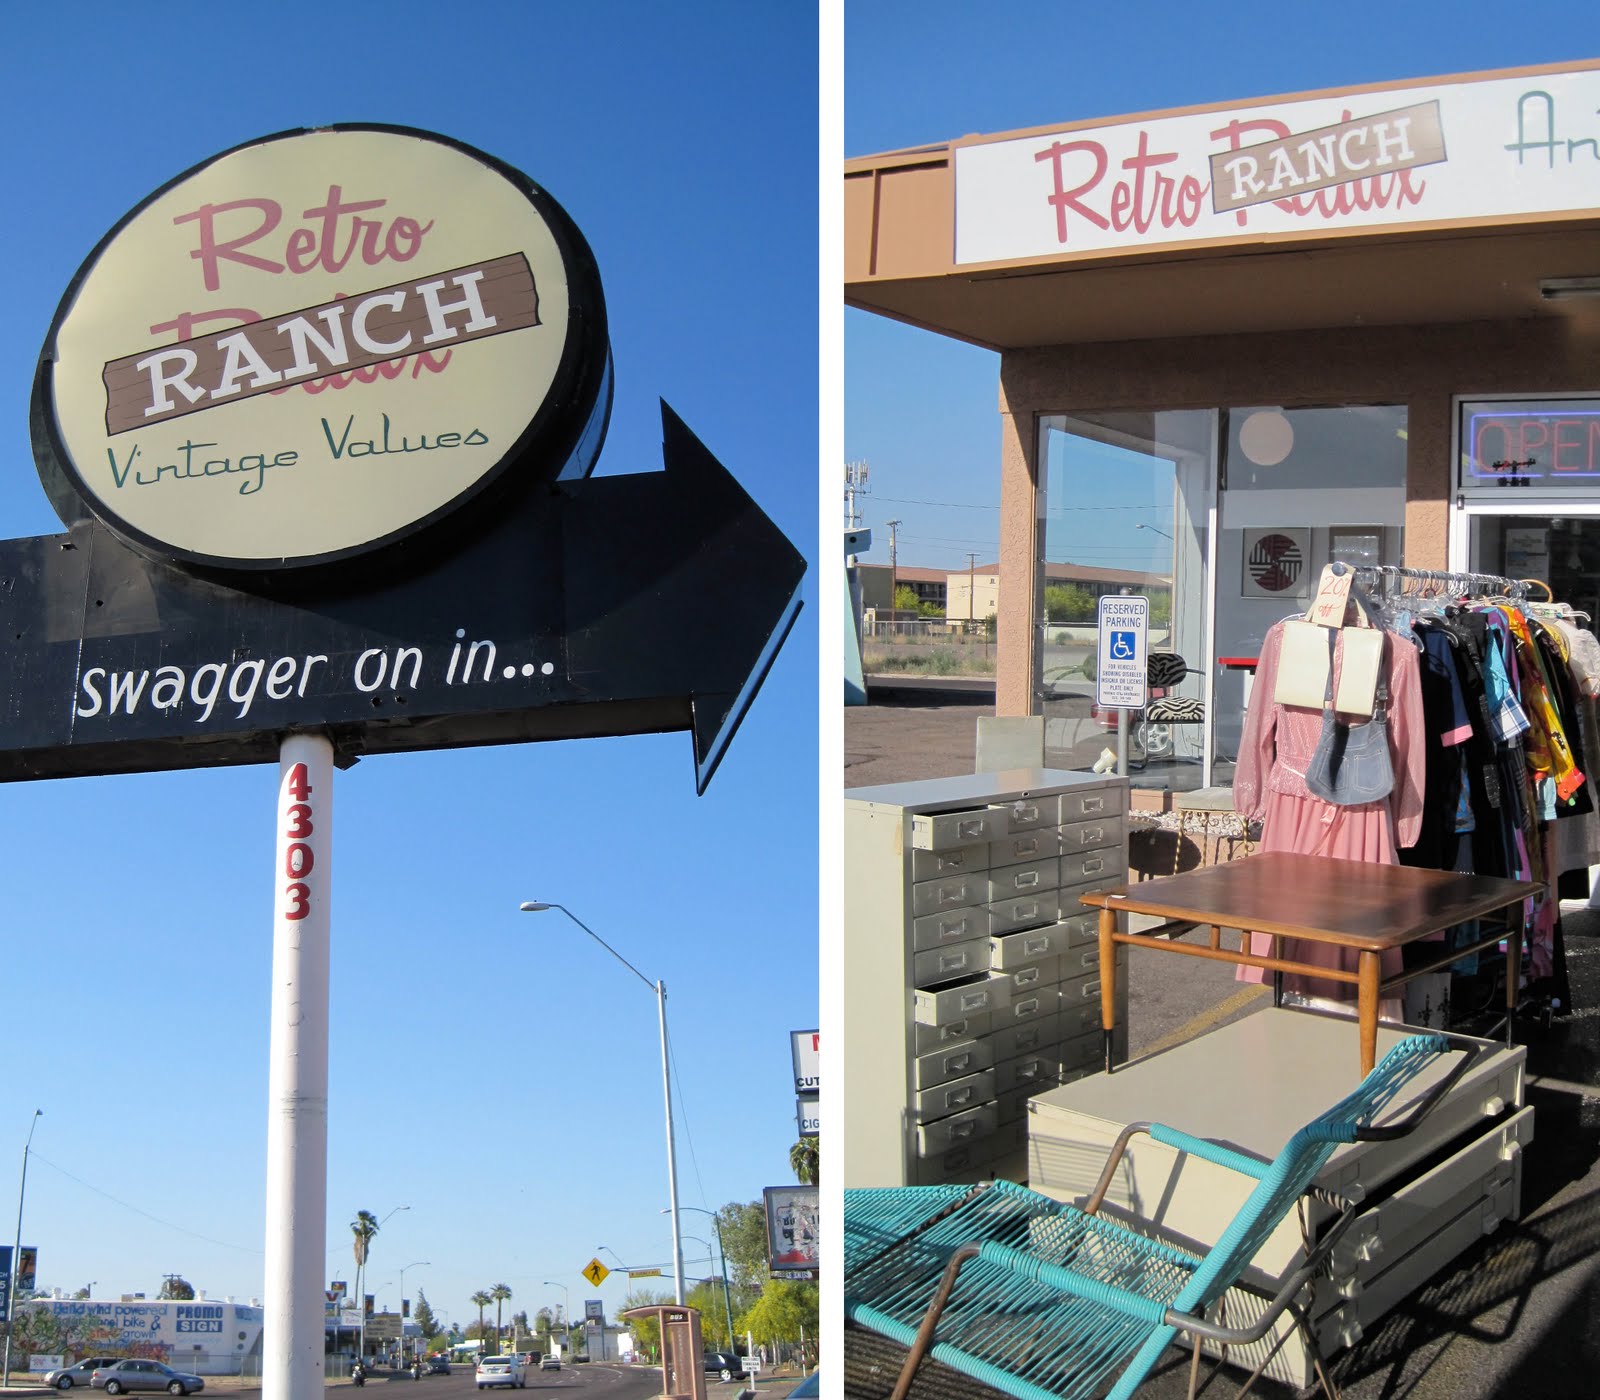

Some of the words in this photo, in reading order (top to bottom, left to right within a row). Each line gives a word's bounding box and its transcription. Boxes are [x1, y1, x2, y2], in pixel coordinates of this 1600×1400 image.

[1223, 116, 1416, 201] RANCH
[1034, 130, 1211, 243] Retro
[173, 184, 434, 292] Retro
[136, 270, 498, 418] RANCH
[106, 441, 300, 495] Vintage
[320, 412, 489, 461] Values
[1102, 604, 1145, 615] RESERVED
[1105, 616, 1141, 628] PARKING
[76, 651, 329, 723] swagger
[353, 645, 421, 692] on
[446, 627, 556, 687] in...
[285, 762, 315, 921] 4303
[115, 1303, 168, 1318] powered
[123, 1315, 146, 1328] bike
[150, 1315, 161, 1331] &
[176, 1305, 223, 1319] PROMO
[180, 1321, 219, 1332] SIGN
[669, 1313, 684, 1321] BUS
